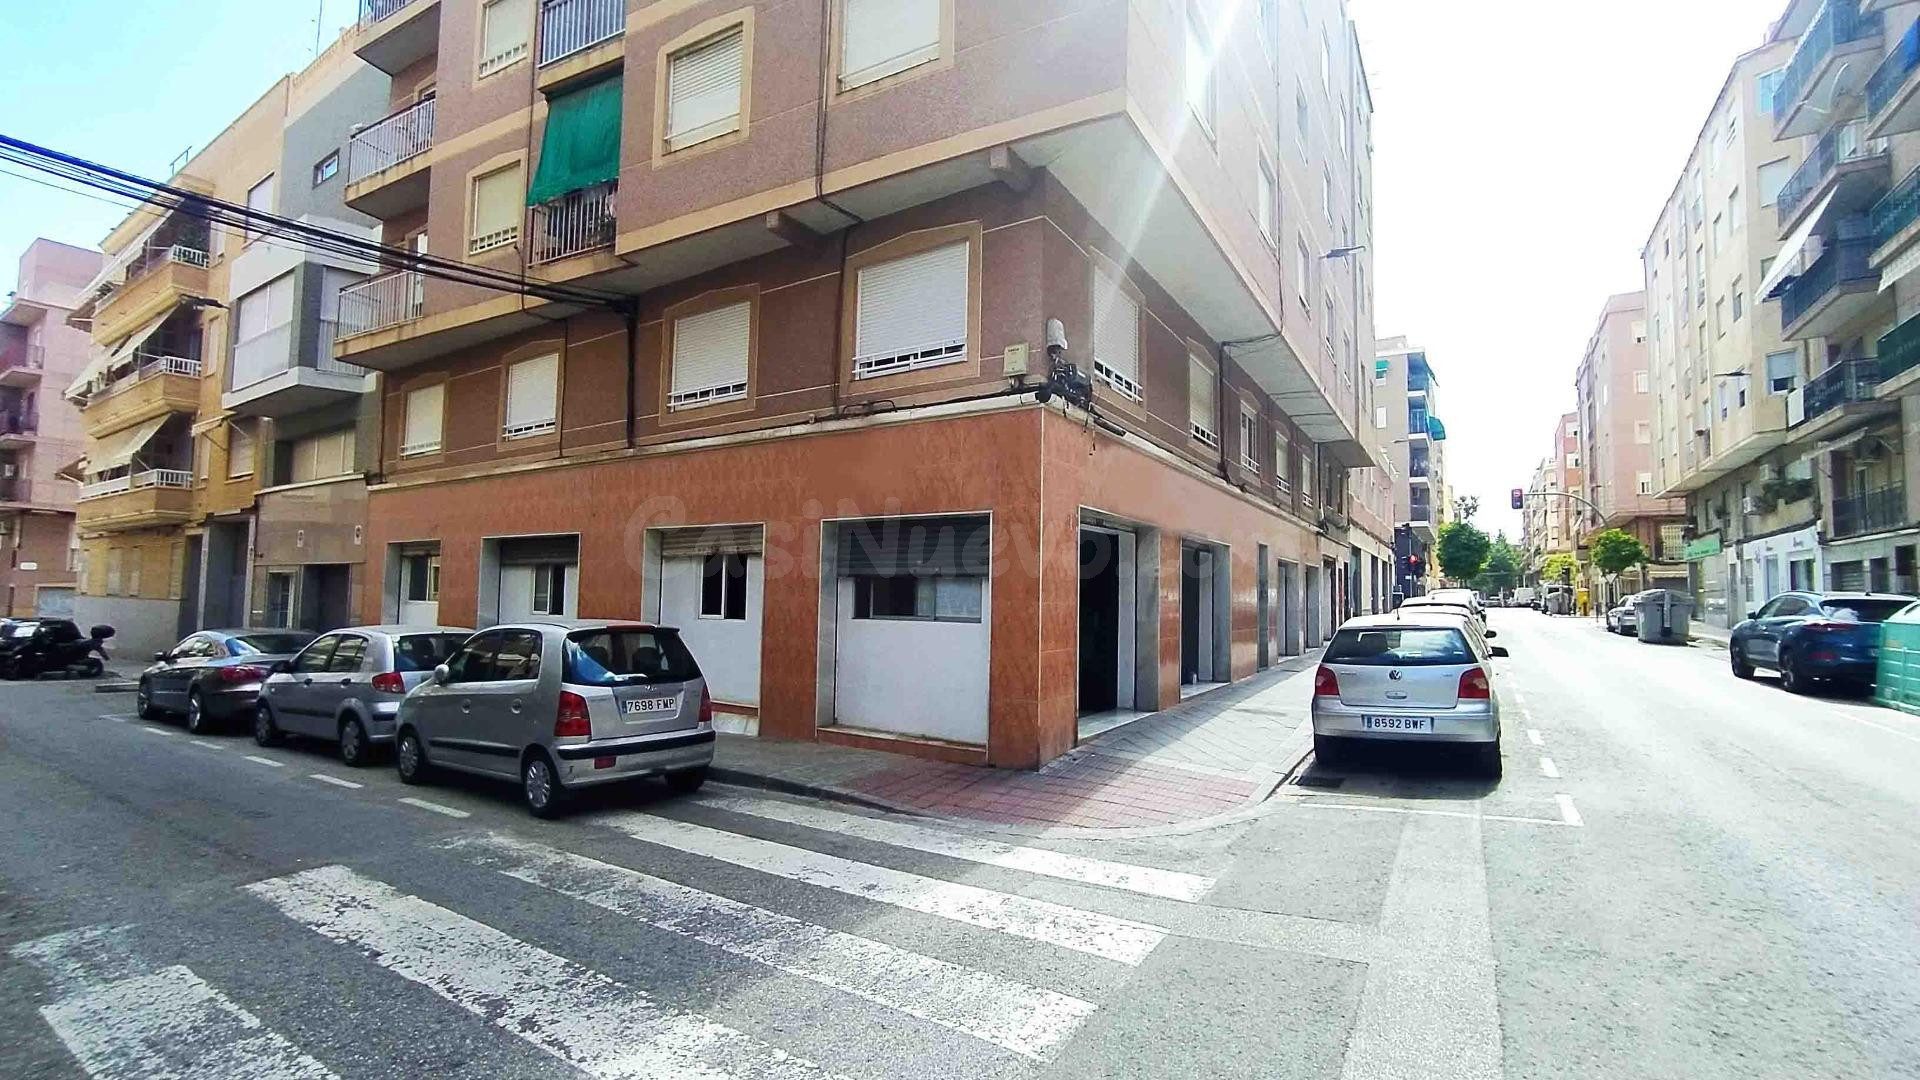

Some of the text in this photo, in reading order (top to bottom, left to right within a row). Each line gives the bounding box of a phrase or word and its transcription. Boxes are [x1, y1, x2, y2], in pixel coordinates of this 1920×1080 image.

[627, 698, 675, 712] 7698 FMP
[1374, 718, 1426, 729] 8592 BWF
